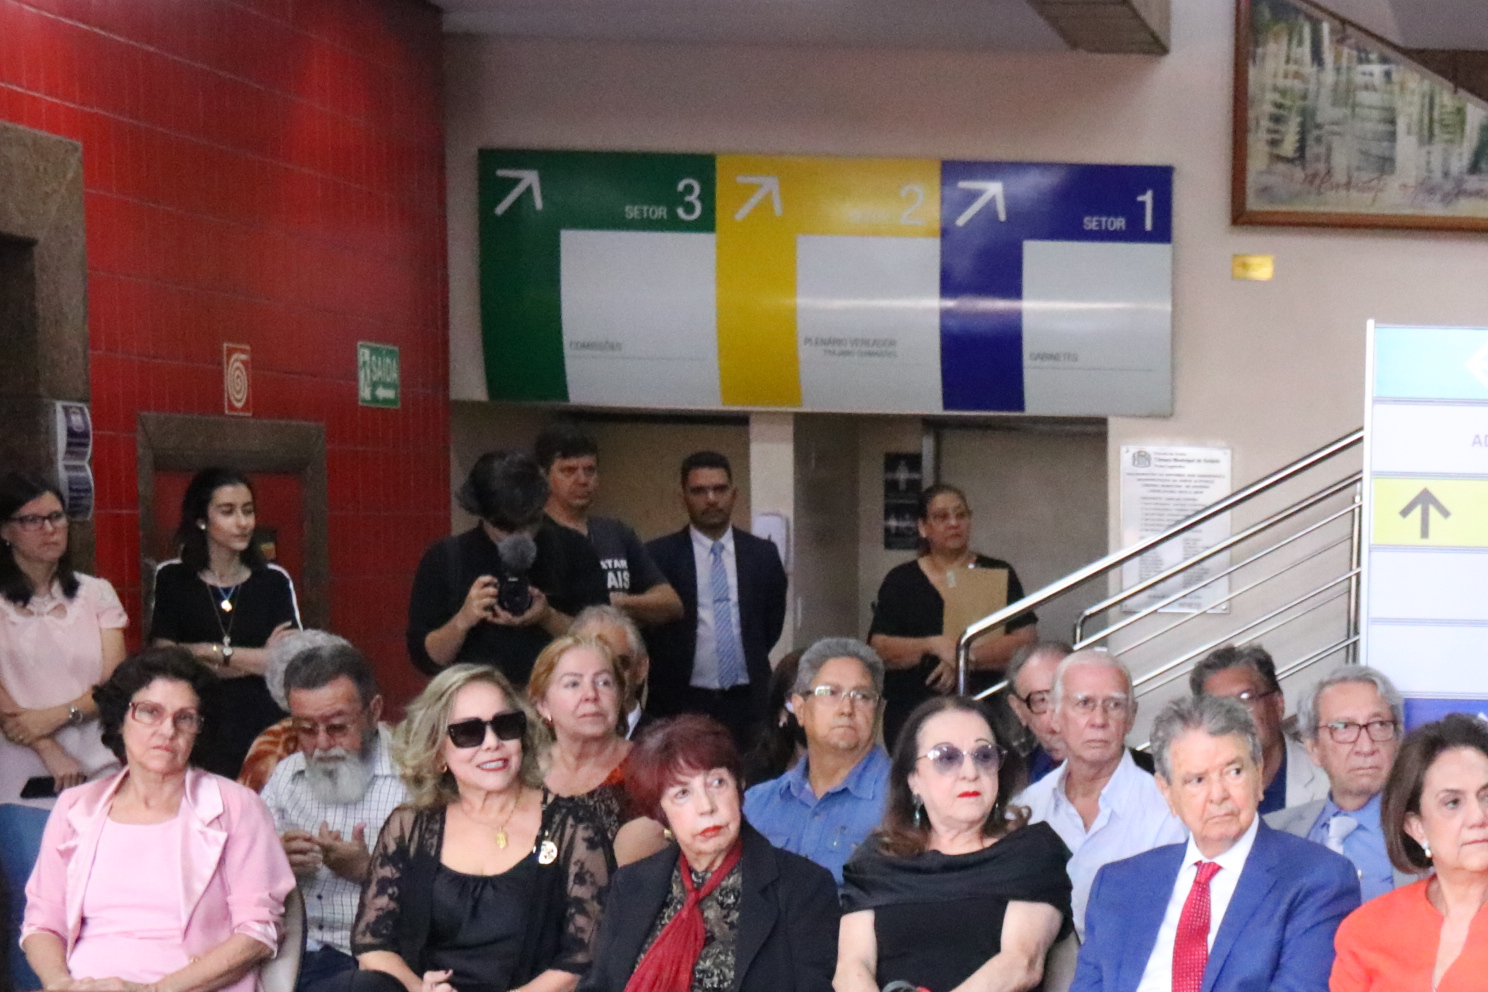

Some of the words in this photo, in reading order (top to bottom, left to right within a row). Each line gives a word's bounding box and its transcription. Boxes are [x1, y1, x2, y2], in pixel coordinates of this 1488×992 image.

[624, 205, 668, 220] SETOR
[676, 178, 703, 221] 3
[899, 183, 926, 227] 2
[1082, 215, 1127, 231] SETOR
[1136, 189, 1153, 231] 1
[371, 350, 398, 383] SAÍDA
